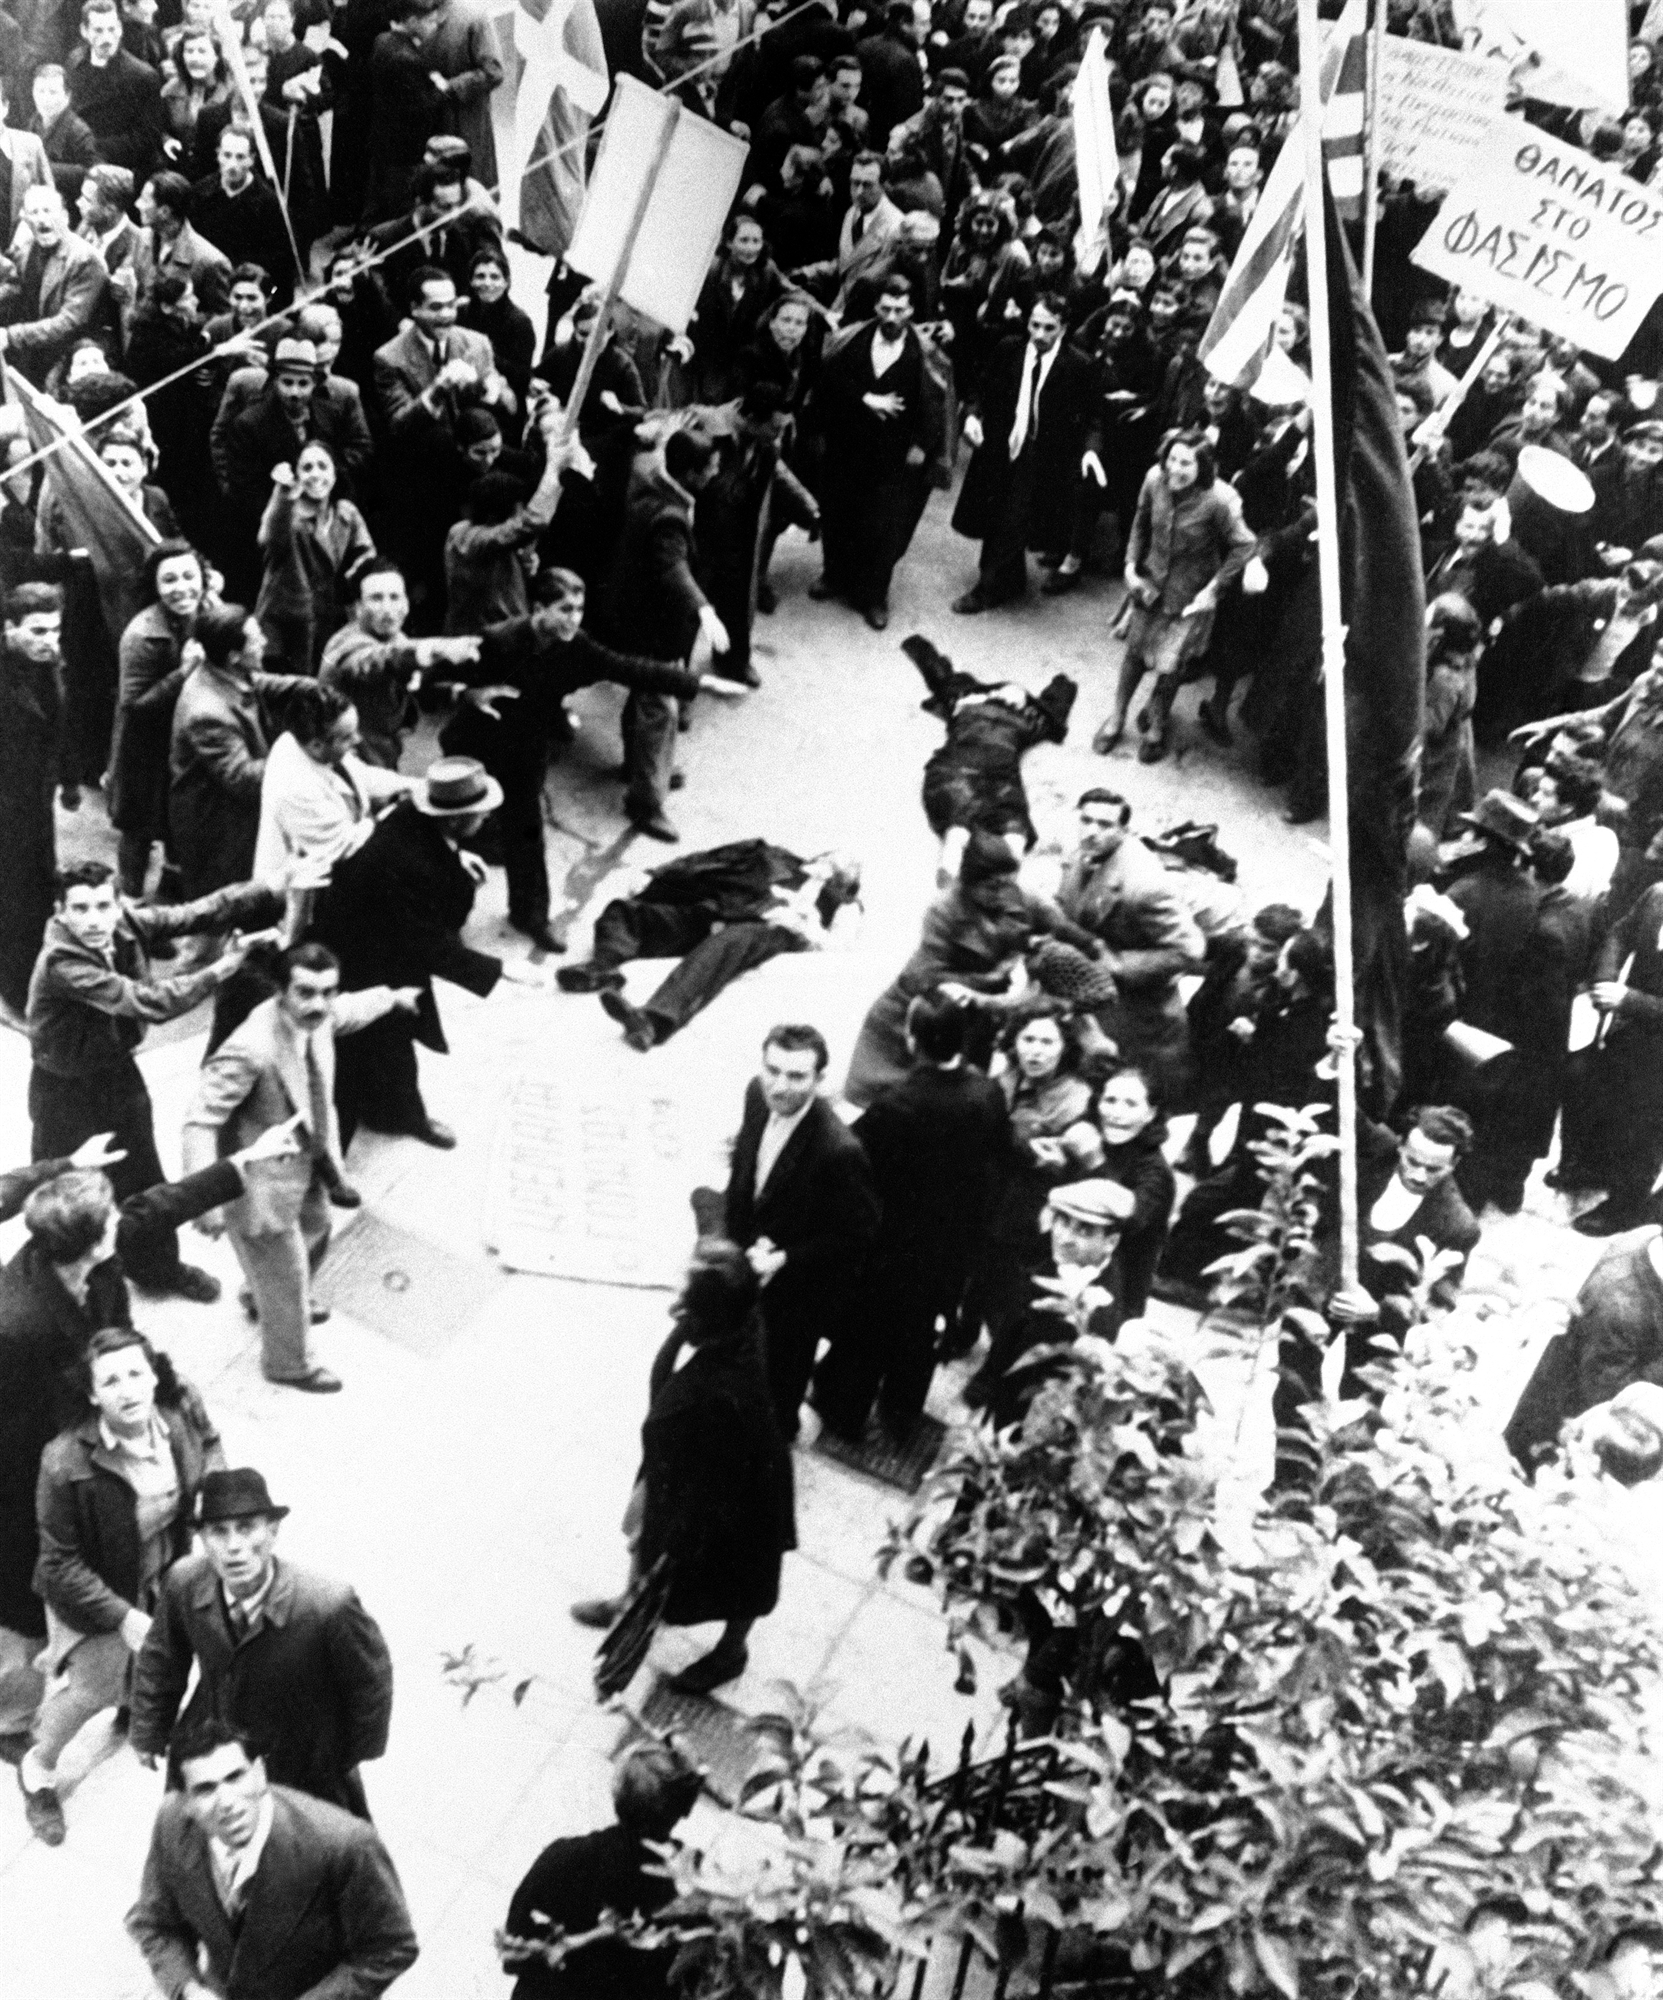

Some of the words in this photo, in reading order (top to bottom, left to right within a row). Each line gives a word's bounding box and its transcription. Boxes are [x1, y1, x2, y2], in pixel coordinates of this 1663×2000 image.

[1515, 144, 1663, 235] ΘΑΝΑΤΟΣ
[1530, 199, 1591, 241] ΣΤΟ
[1444, 210, 1629, 321] ΦΑΣΙΣΜΟ
